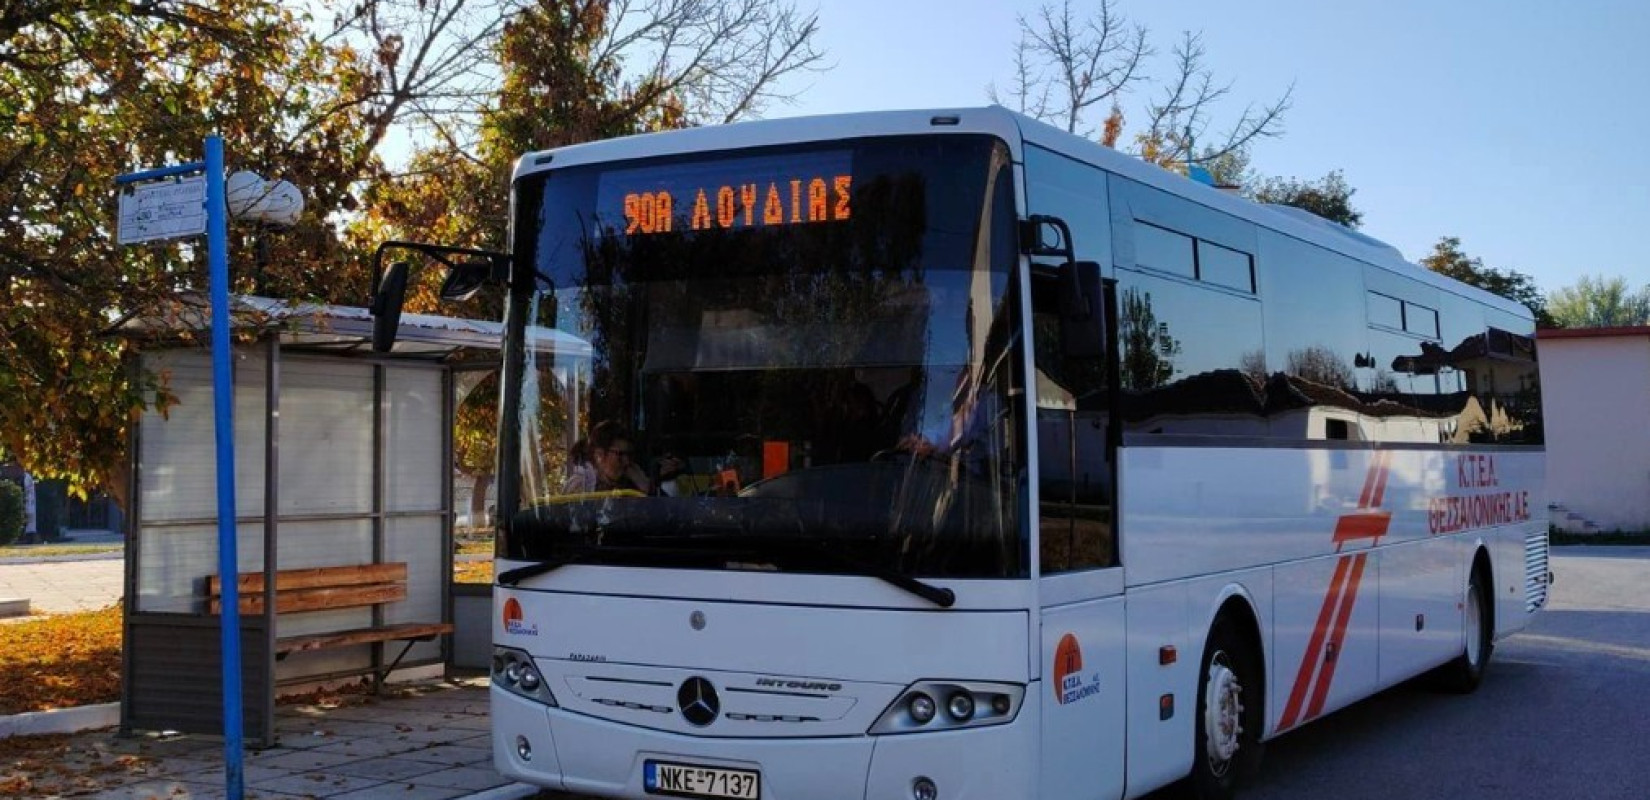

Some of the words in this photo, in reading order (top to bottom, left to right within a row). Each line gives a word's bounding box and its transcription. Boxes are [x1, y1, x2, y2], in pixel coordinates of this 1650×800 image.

[691, 175, 853, 230] ΛΟΥΔΙΑΣ
[1427, 492, 1511, 534] ΘΕΣΣΑΛΟΝΙΚΗΣ
[756, 678, 842, 691] INTOURO
